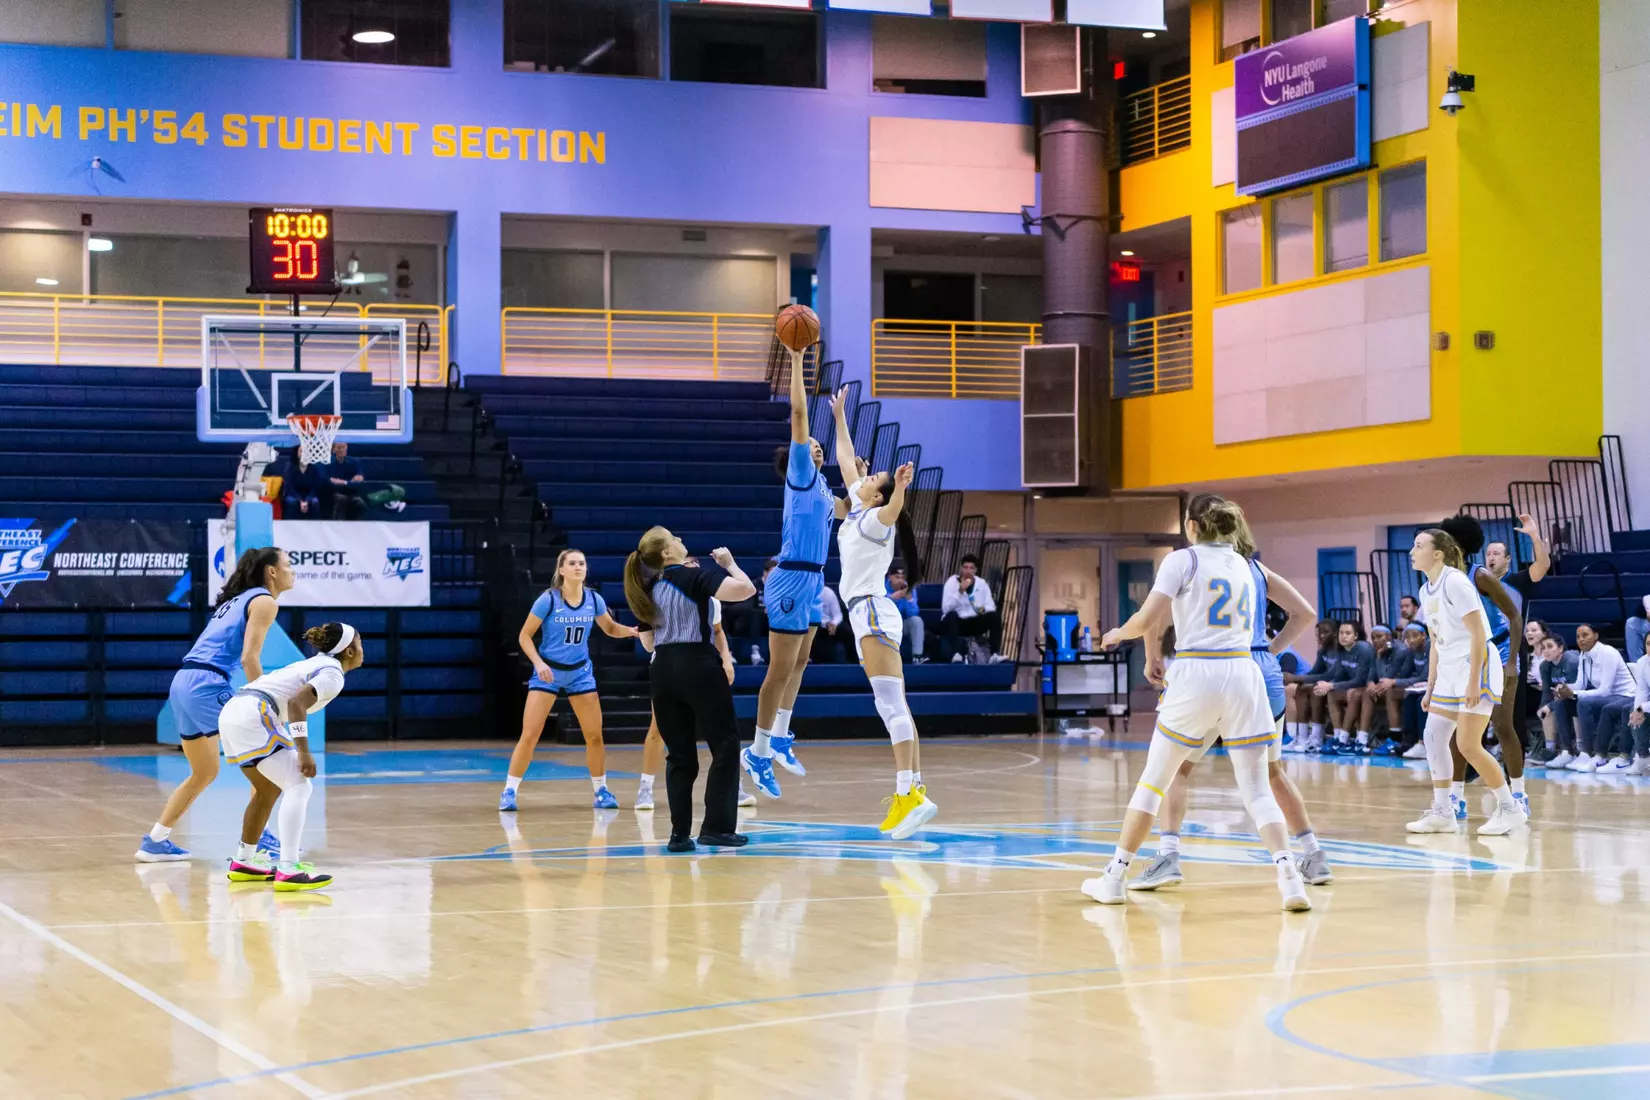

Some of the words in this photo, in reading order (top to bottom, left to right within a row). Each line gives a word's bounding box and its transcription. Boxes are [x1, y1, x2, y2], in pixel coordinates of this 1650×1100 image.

[1264, 65, 1285, 87] NYU
[1286, 56, 1328, 80] Langone
[1281, 77, 1315, 102] Health
[79, 106, 209, 146] PH'54
[222, 114, 420, 156] STUDENT
[432, 124, 606, 164] SECTION
[267, 213, 328, 239] 10:00
[273, 240, 318, 279] 30
[53, 552, 118, 568] NORTHEAST
[119, 552, 190, 568] CONFERENCE
[286, 550, 350, 566] SPECT.
[382, 555, 423, 575] NEC
[320, 570, 330, 580] of
[331, 570, 345, 580] the
[1206, 577, 1251, 631] 24
[564, 626, 585, 645] 10
